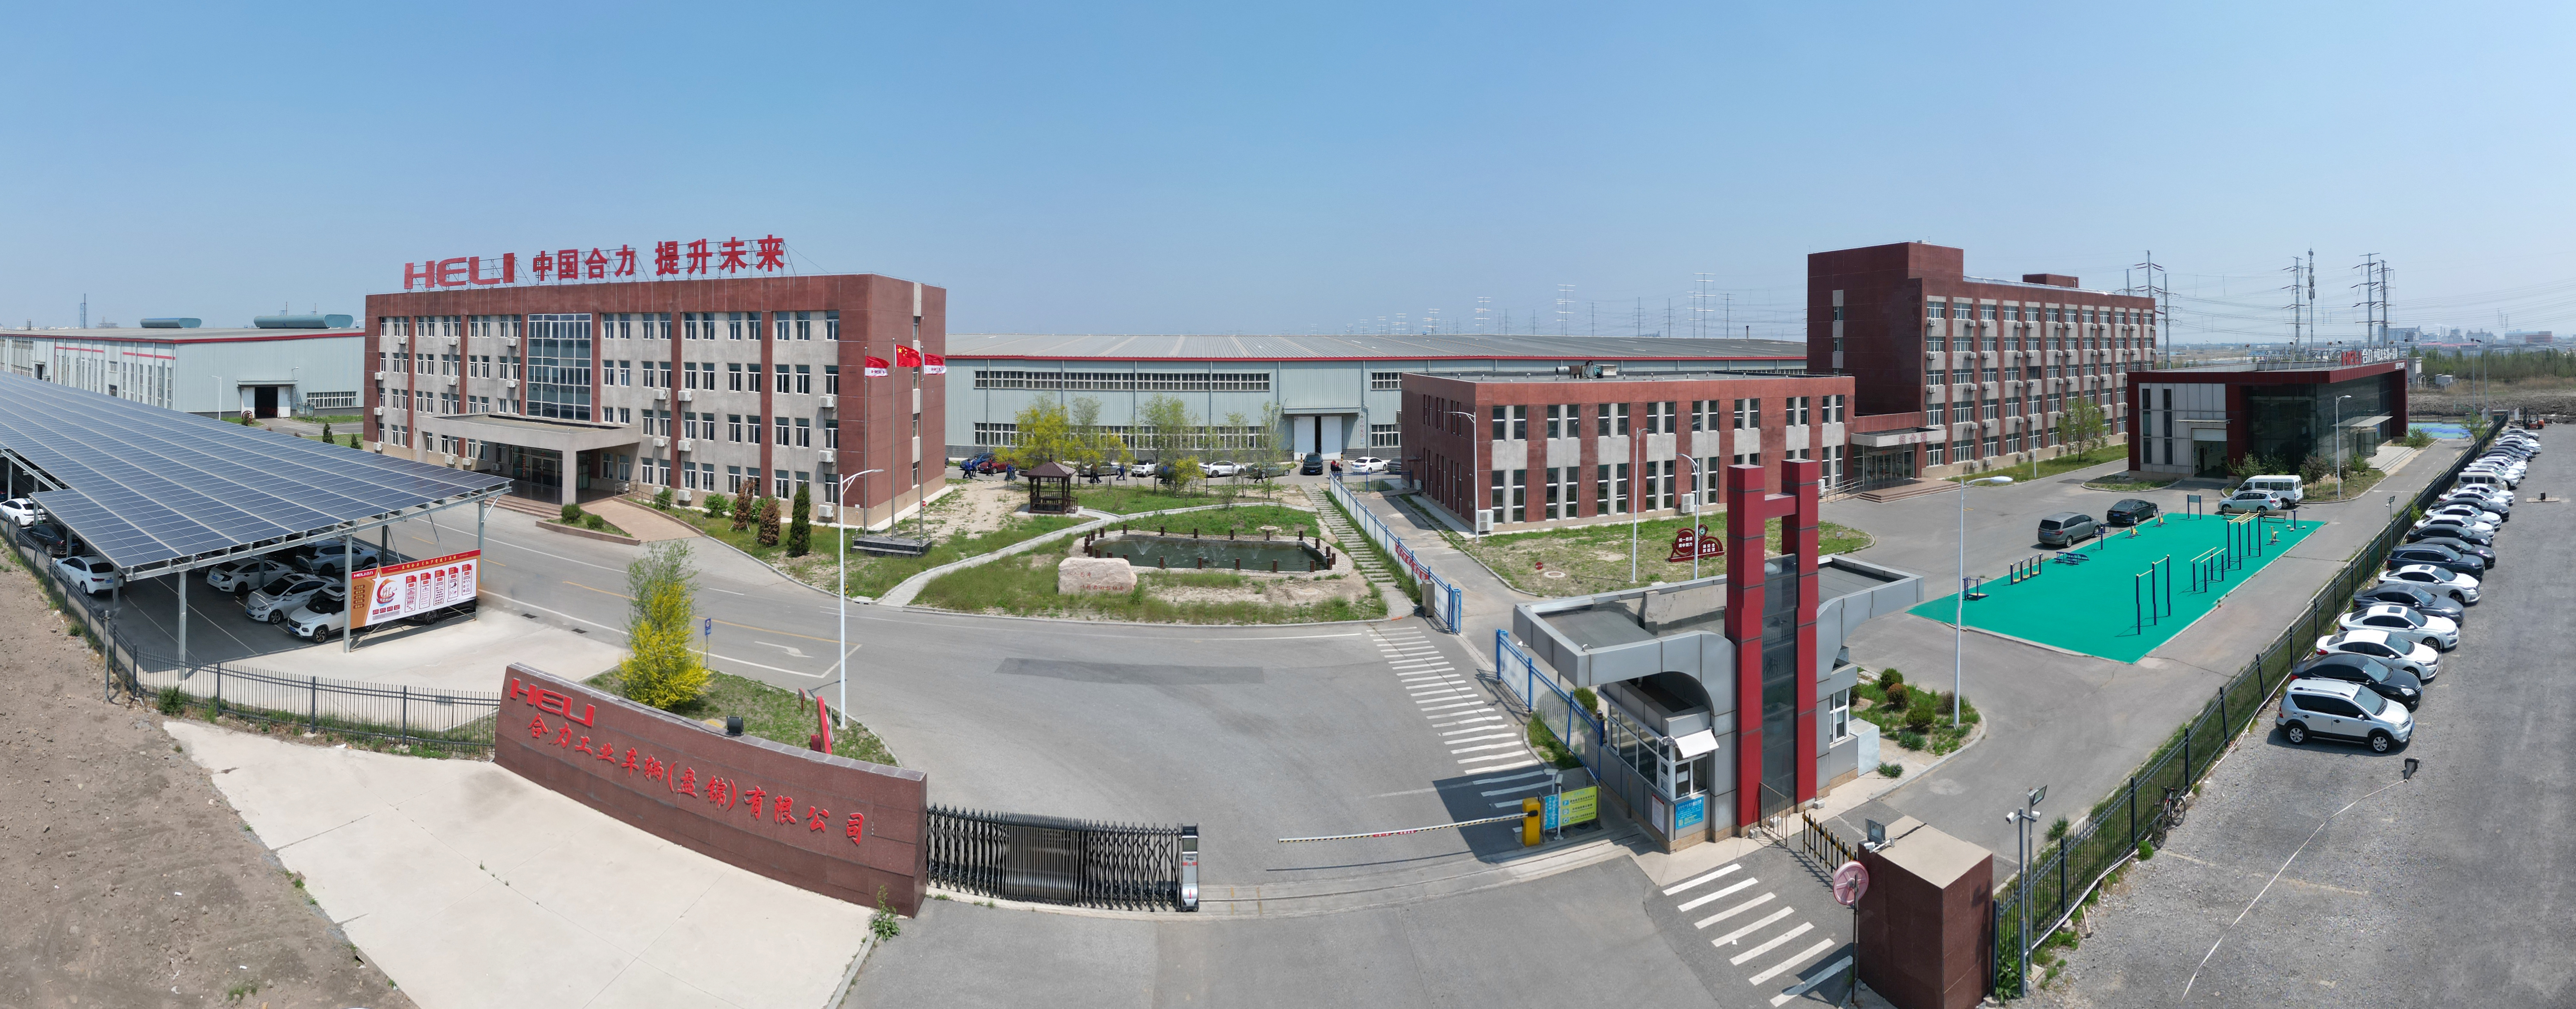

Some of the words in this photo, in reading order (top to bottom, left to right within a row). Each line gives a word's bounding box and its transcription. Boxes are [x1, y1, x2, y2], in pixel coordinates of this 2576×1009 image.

[404, 252, 514, 289] HELI
[533, 245, 636, 281] 中国合力
[655, 234, 784, 276] 提升未来
[2342, 350, 2362, 366] HELI
[2362, 348, 2373, 364] 合力
[1899, 432, 1927, 445] 综合楼
[510, 677, 596, 728] HELI
[528, 713, 864, 846] 合力工业车辆（盘锦）有限公司
